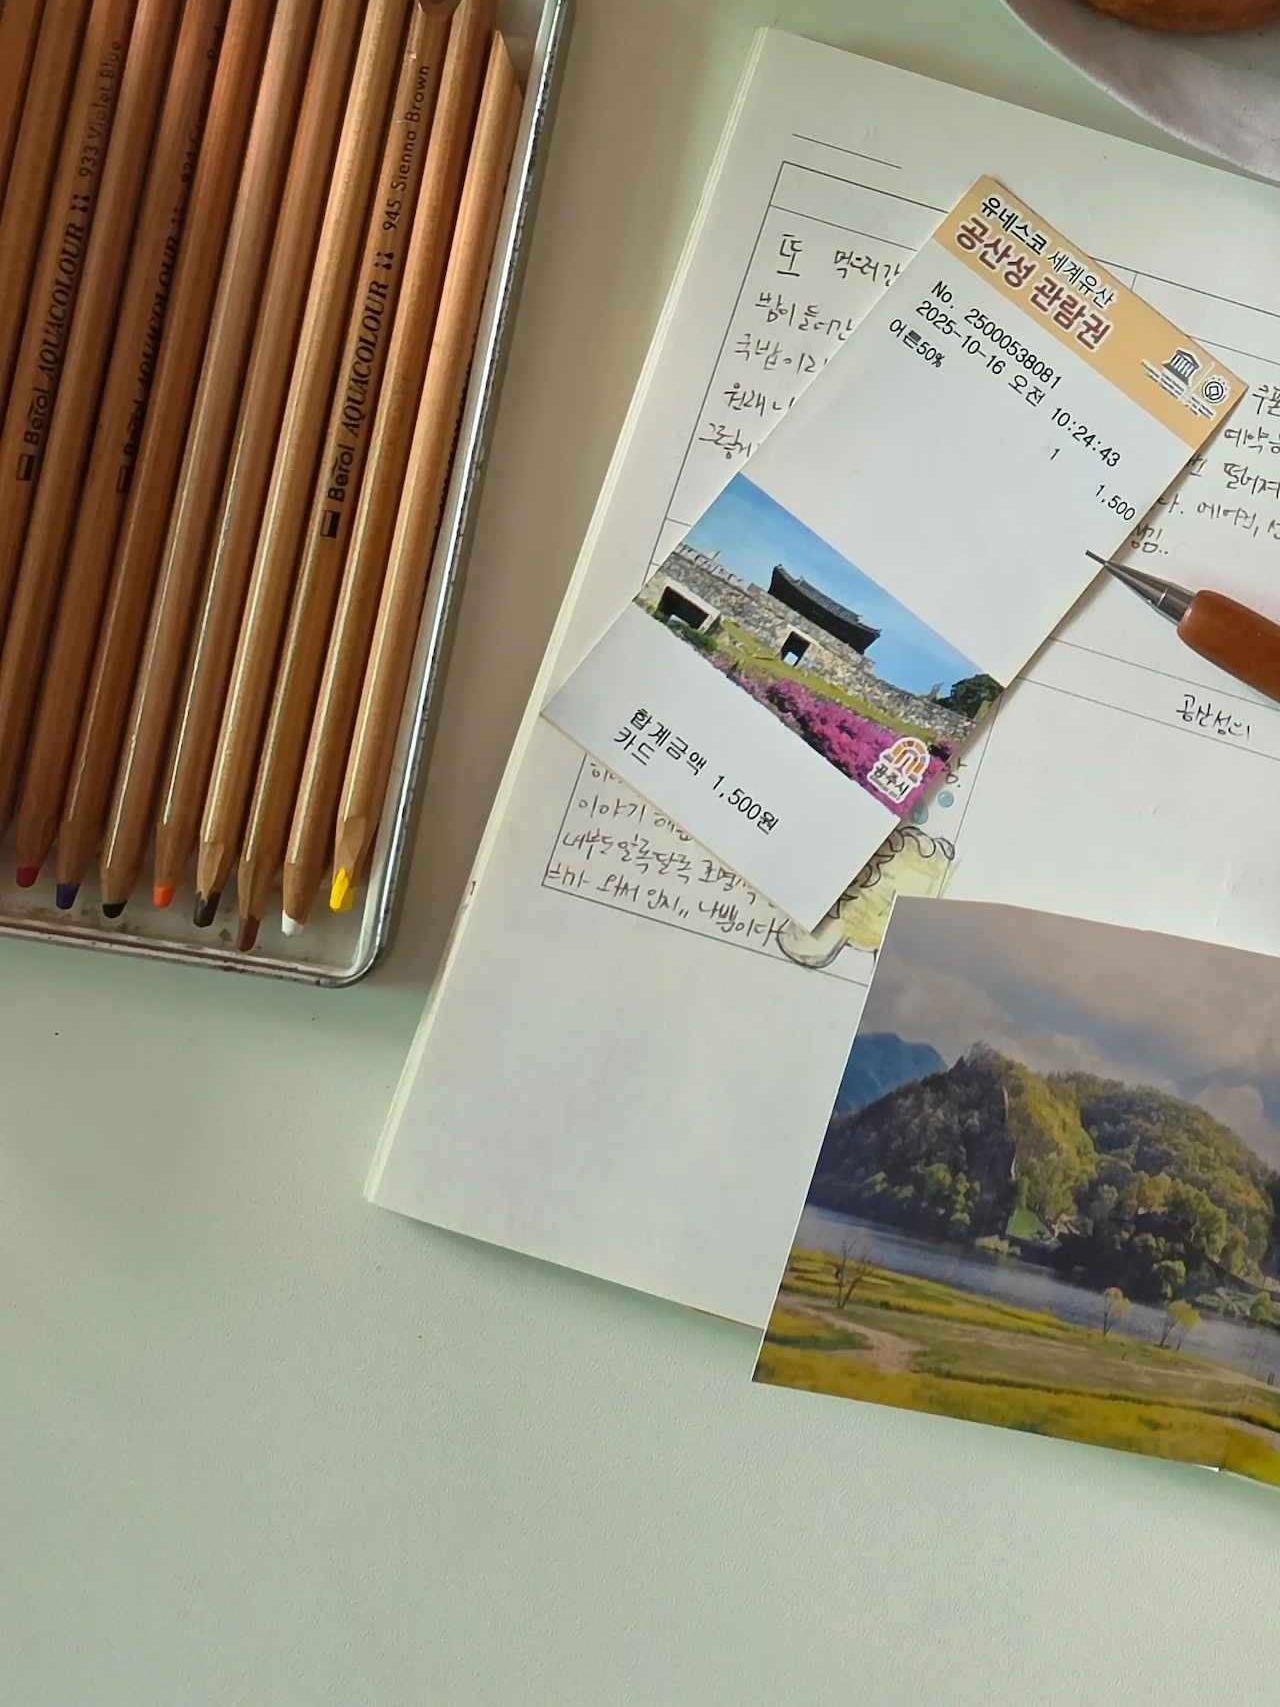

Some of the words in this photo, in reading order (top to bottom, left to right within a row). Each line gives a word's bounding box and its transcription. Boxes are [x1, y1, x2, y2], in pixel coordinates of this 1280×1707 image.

[98, 39, 122, 79] Blue
[85, 82, 113, 140] Violet
[403, 62, 431, 122] Brown
[77, 142, 100, 178] 933
[388, 128, 418, 192] Sienna
[380, 197, 405, 233] 945
[776, 233, 803, 277] 또
[982, 198, 1047, 255] 유네스코
[1048, 252, 1113, 308] 세계유산
[35, 222, 85, 381] AQUACOLOUR
[957, 218, 1036, 287] 공산성
[1031, 277, 1110, 349] 관람권
[339, 278, 390, 437] AQUACOLOUR
[932, 281, 953, 308] No.
[965, 309, 1061, 388] 25000538081
[916, 301, 1005, 374] 2025-10-16
[1009, 375, 1045, 406] 오전
[1052, 408, 1120, 466] 10:24:43
[21, 386, 50, 445] Berol
[889, 319, 946, 368] 어른50%
[1050, 448, 1060, 461] 1
[1095, 484, 1136, 521] 1,500
[325, 442, 356, 503] Berol
[614, 727, 655, 766] 카드
[1176, 694, 1251, 743] 공산성의
[630, 708, 707, 776] 합계금액
[712, 775, 779, 835] 1,500원
[874, 763, 909, 795] 공주시
[578, 794, 647, 823] 이야기
